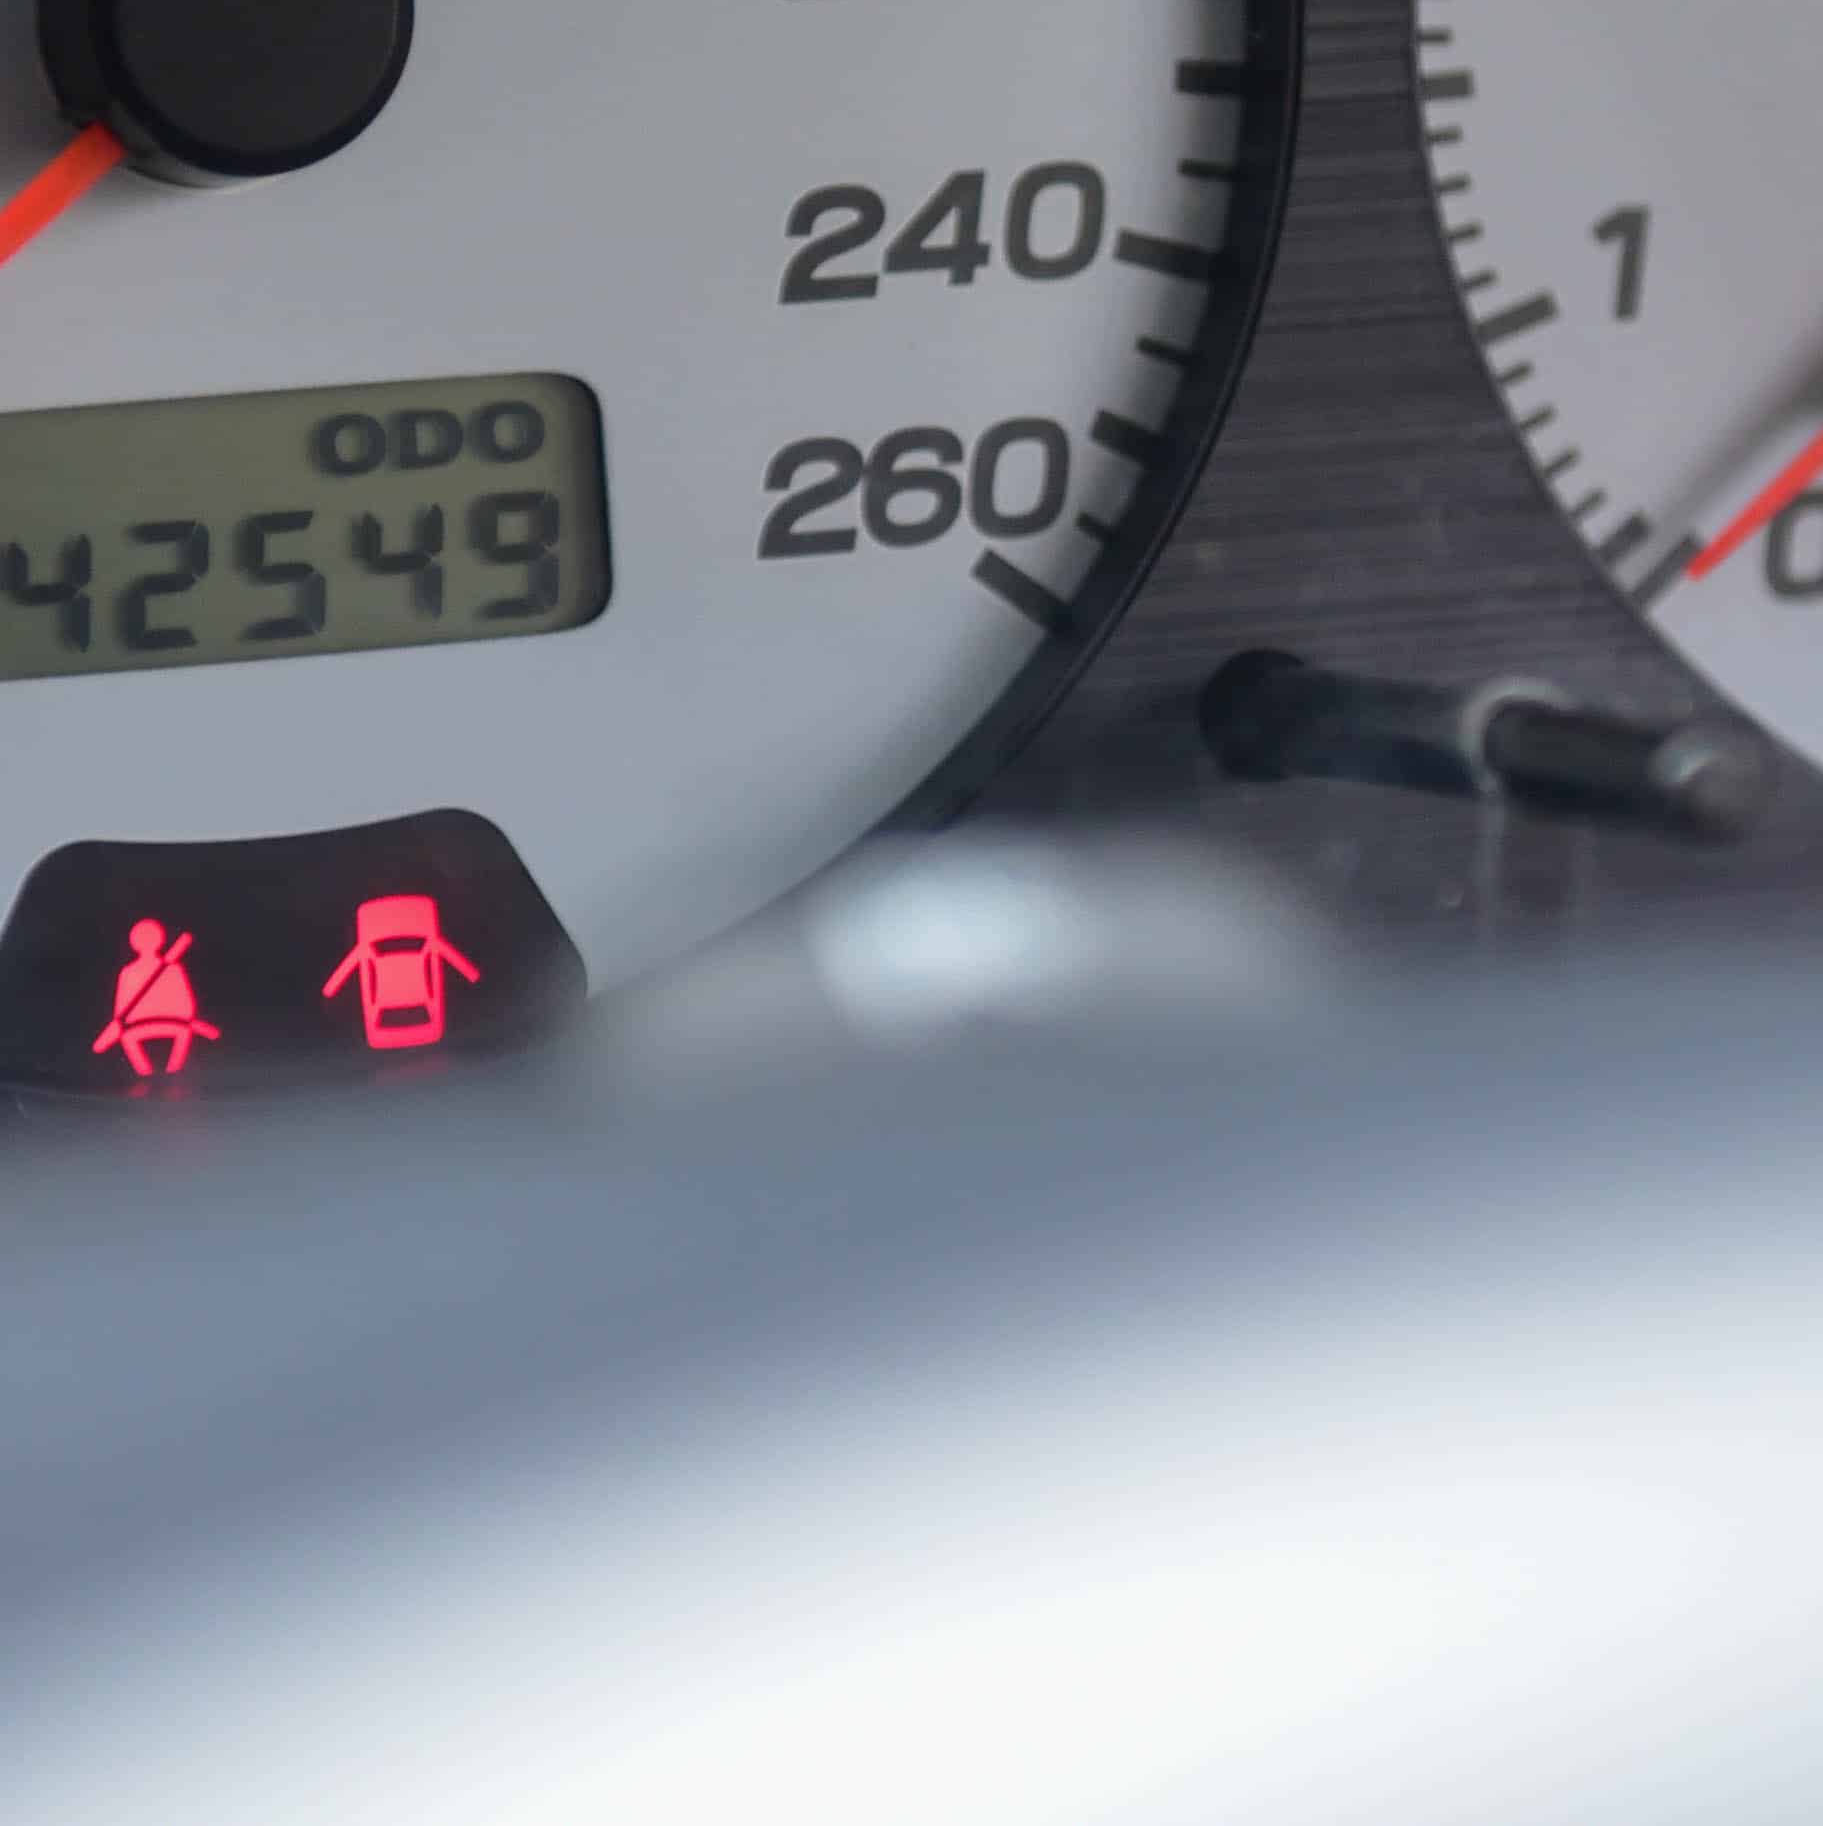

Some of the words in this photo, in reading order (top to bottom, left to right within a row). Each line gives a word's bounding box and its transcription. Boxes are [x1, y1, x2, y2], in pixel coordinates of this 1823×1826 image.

[778, 161, 1105, 305] 240
[1592, 205, 1649, 320] 1
[316, 402, 545, 477] ODO
[757, 416, 1071, 560] 260
